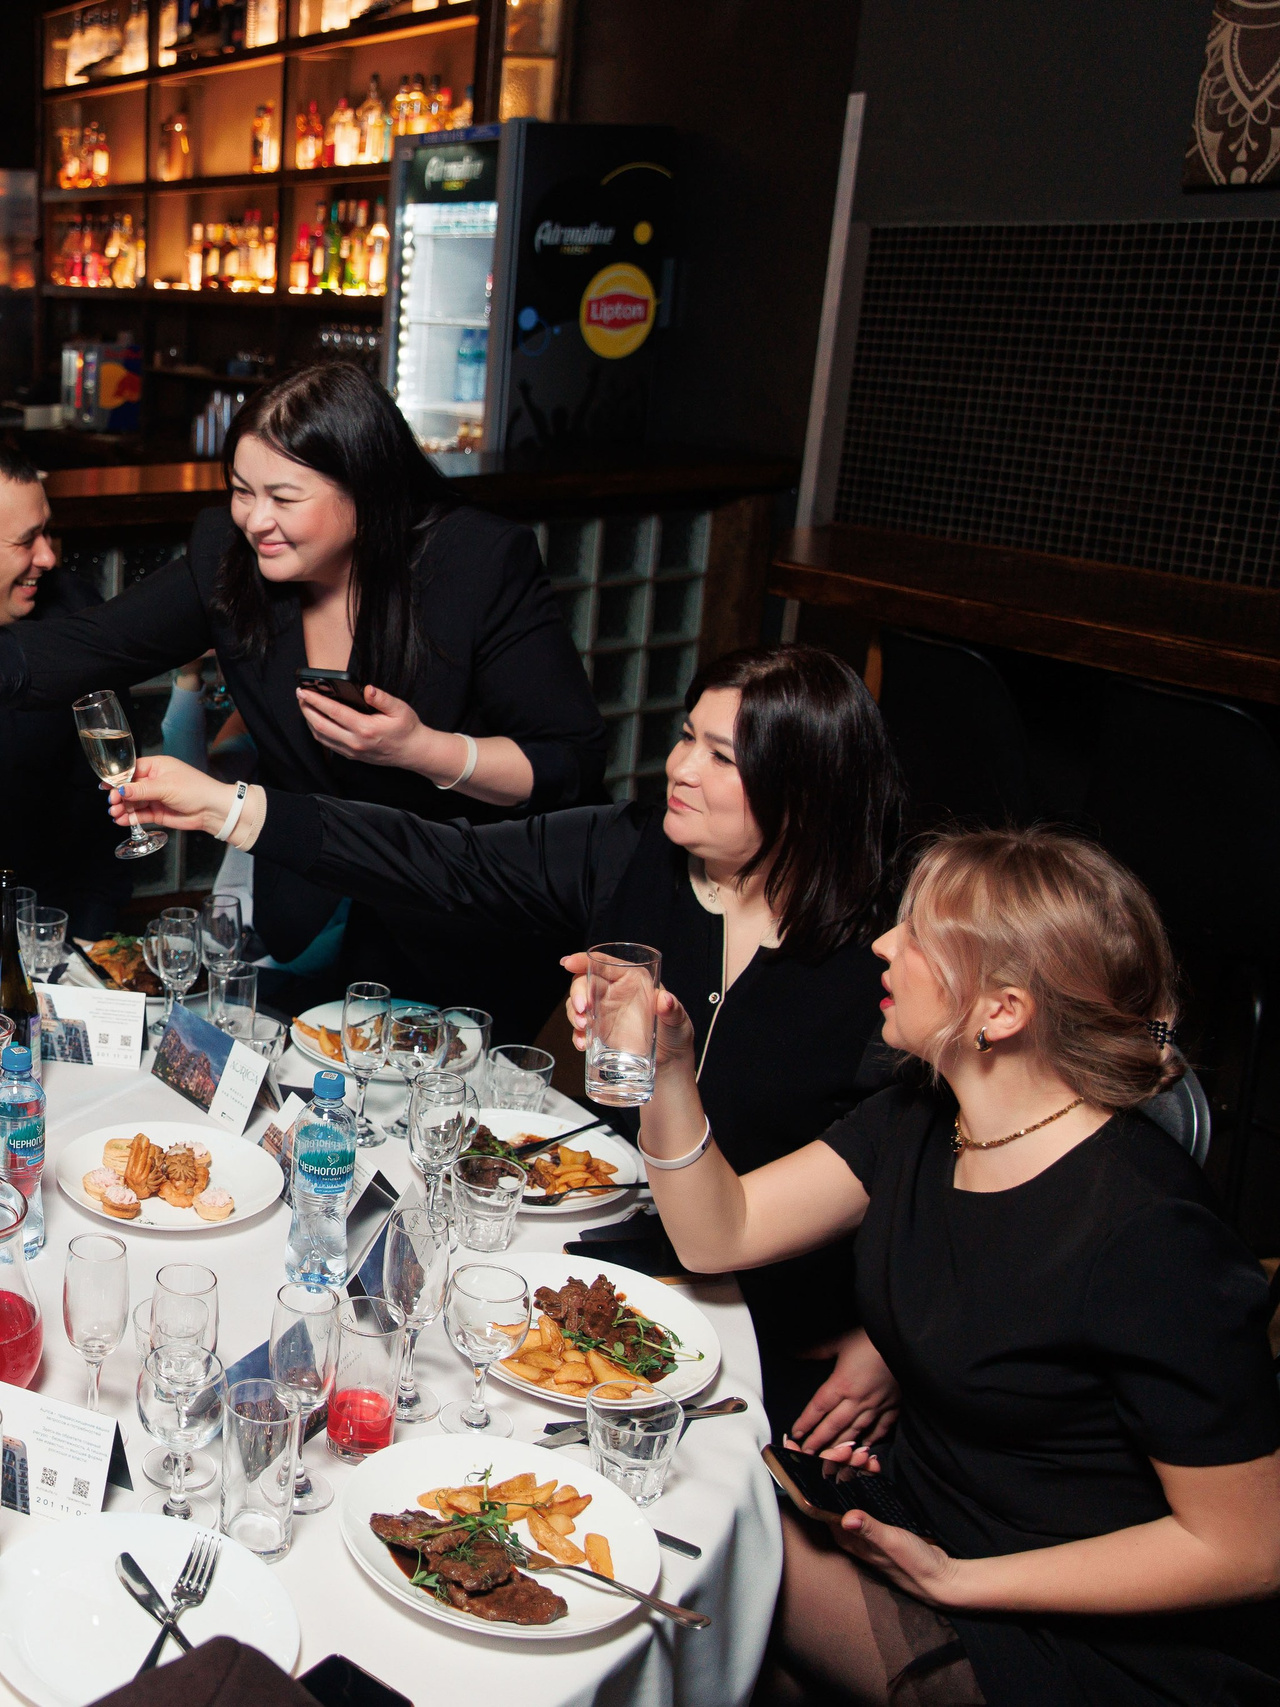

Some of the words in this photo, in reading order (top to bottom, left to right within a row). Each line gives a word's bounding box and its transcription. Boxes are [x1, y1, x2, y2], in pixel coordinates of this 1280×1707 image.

[534, 219, 616, 253] Adrenaline
[590, 302, 645, 323] Lipton
[300, 1159, 354, 1176] ЧЕРНОГОЛОВК
[36, 1496, 54, 1508] 201
[61, 1504, 69, 1513] 11
